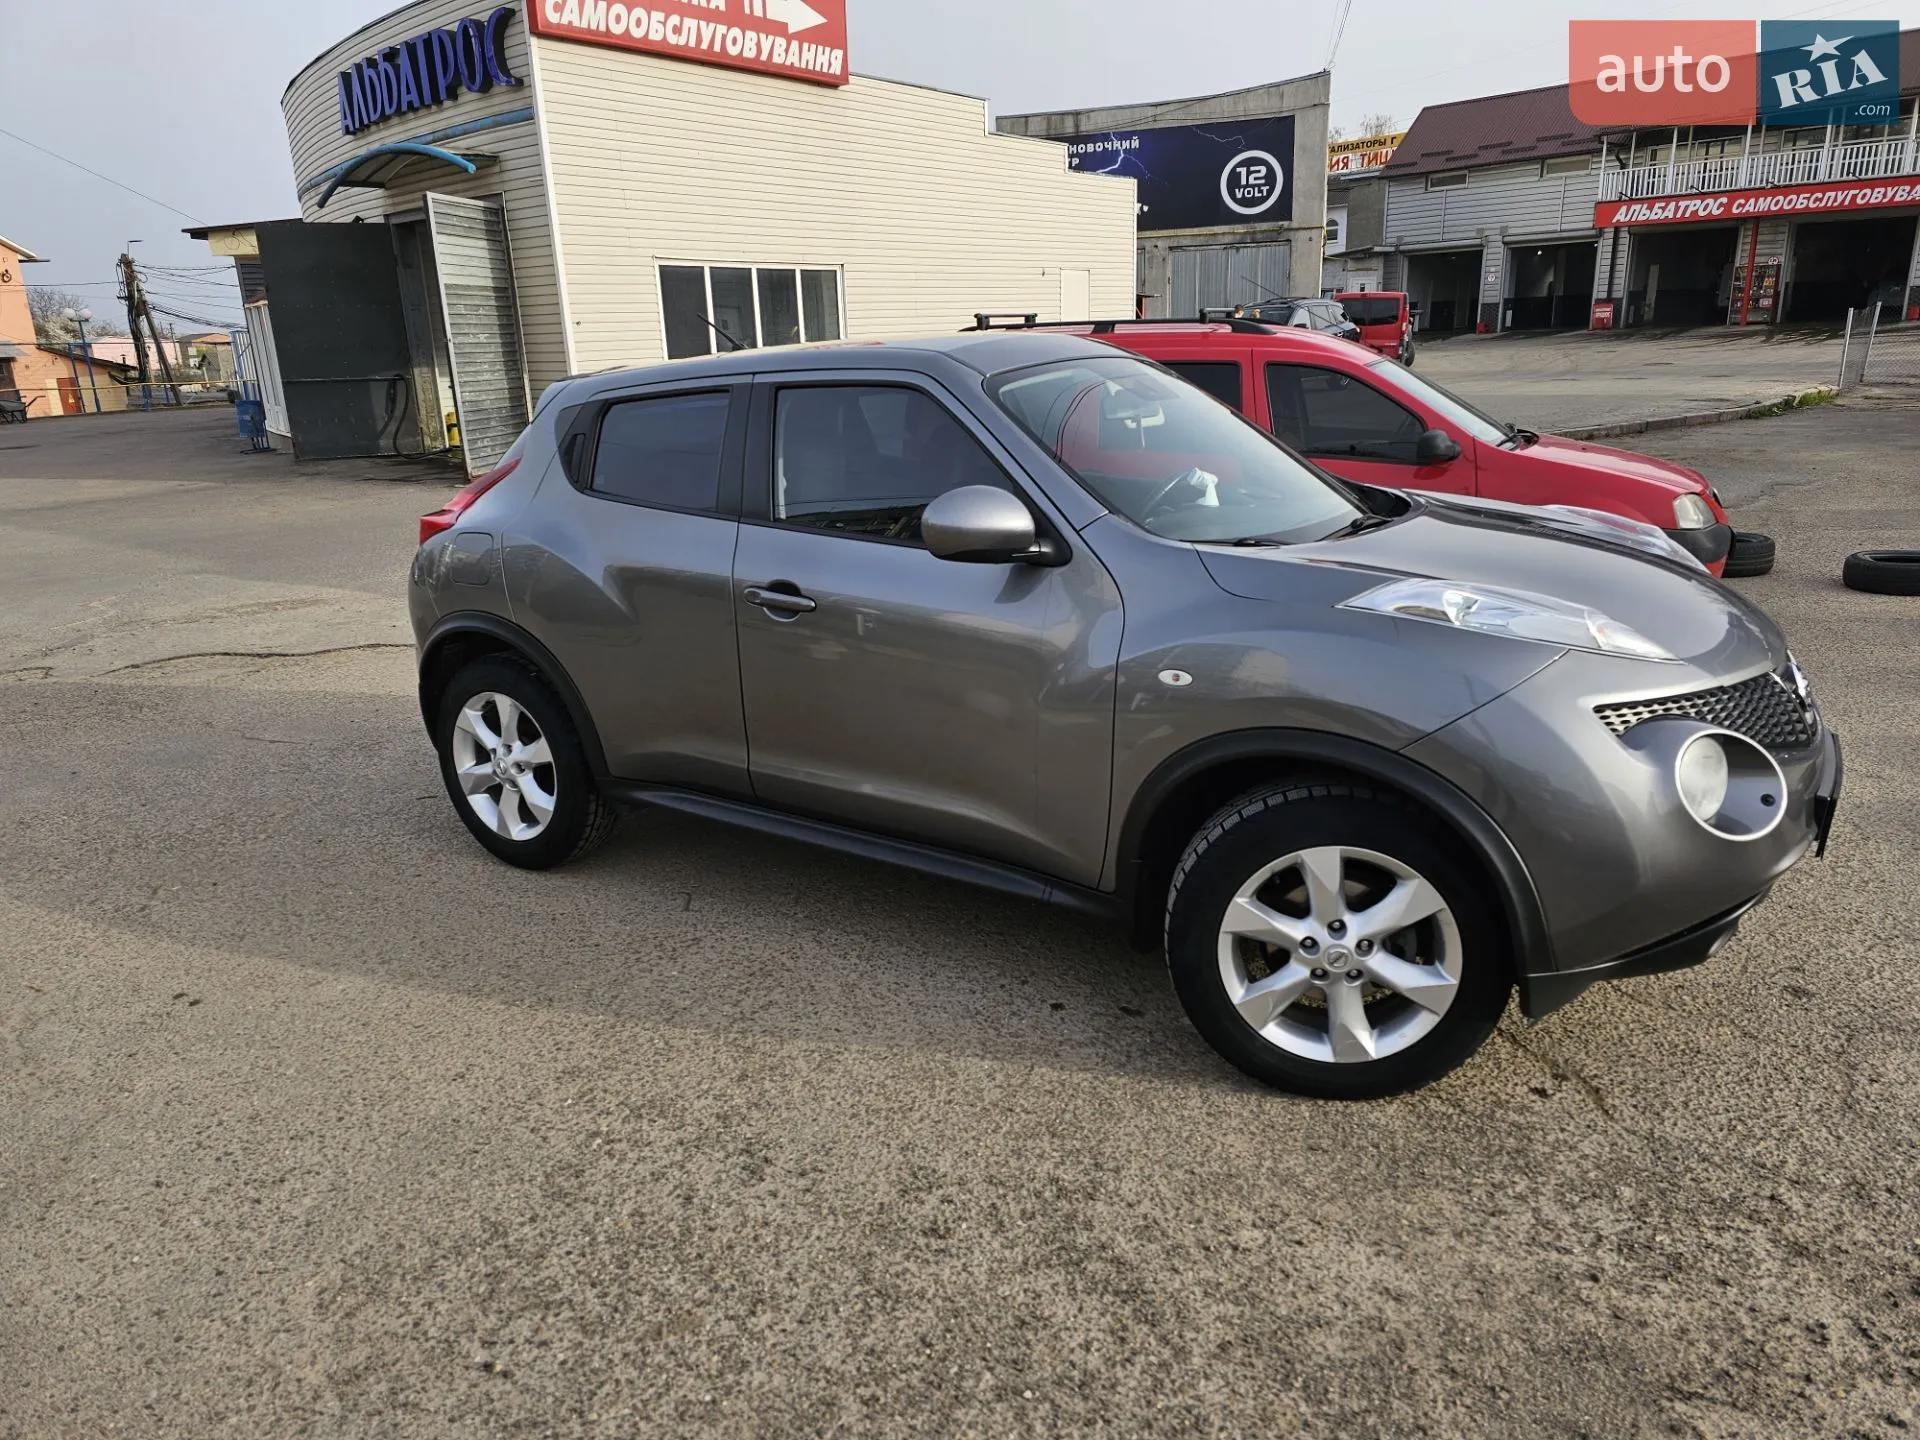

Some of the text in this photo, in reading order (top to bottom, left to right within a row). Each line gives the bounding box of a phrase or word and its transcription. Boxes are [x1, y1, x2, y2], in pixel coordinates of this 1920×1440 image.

[545, 0, 843, 75] САМООБСЛУГОВУВАННЯ
[338, 7, 523, 135] АЛЬБАТРОС
[1328, 138, 1387, 153] АЛИЗАТОРЫ
[1236, 166, 1267, 185] 12
[1235, 186, 1270, 198] VOLT
[1611, 197, 1728, 223] АЛЬБАТРОС
